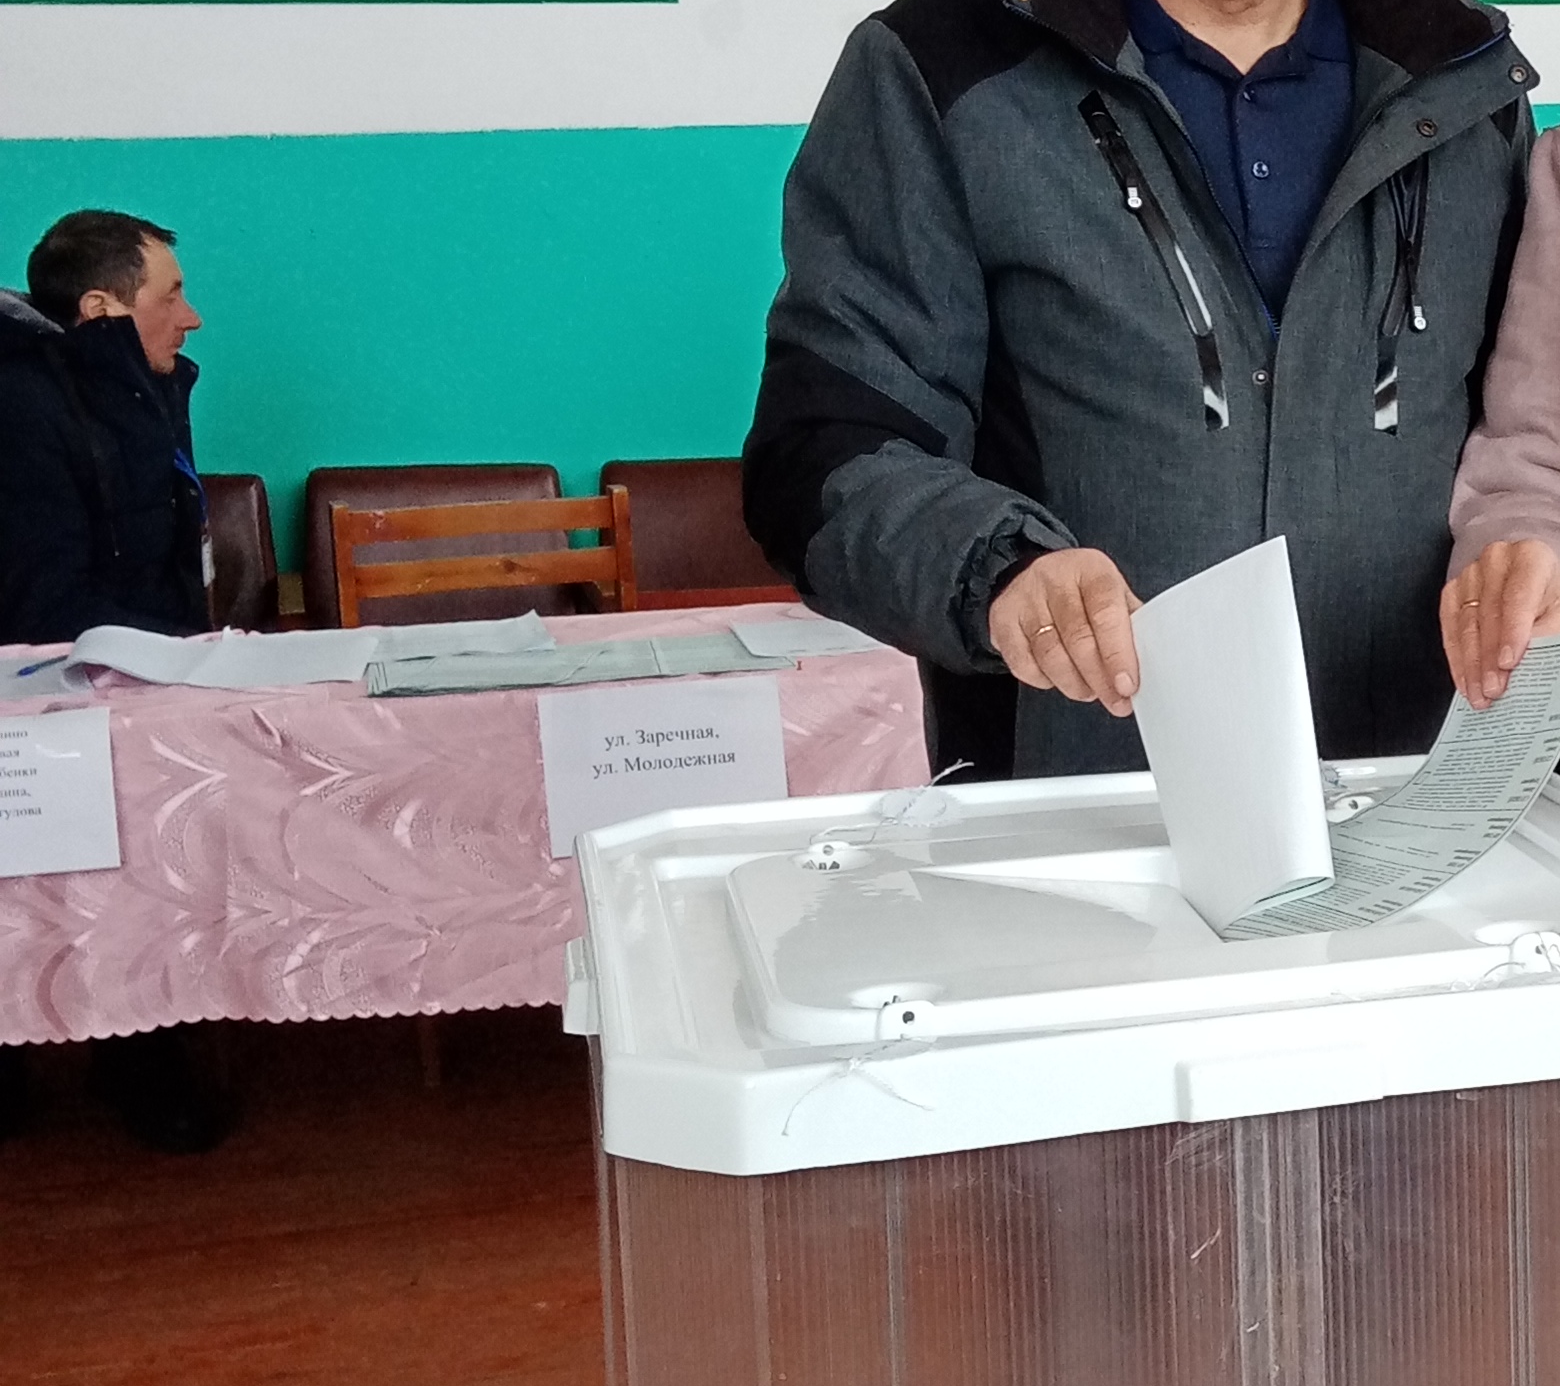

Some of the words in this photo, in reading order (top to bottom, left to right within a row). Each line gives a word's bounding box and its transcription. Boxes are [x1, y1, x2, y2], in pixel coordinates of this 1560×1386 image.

[604, 735, 630, 752] ул.
[635, 727, 720, 747] Заречная,
[592, 763, 618, 780] ул.
[624, 751, 736, 773] Молодежная
